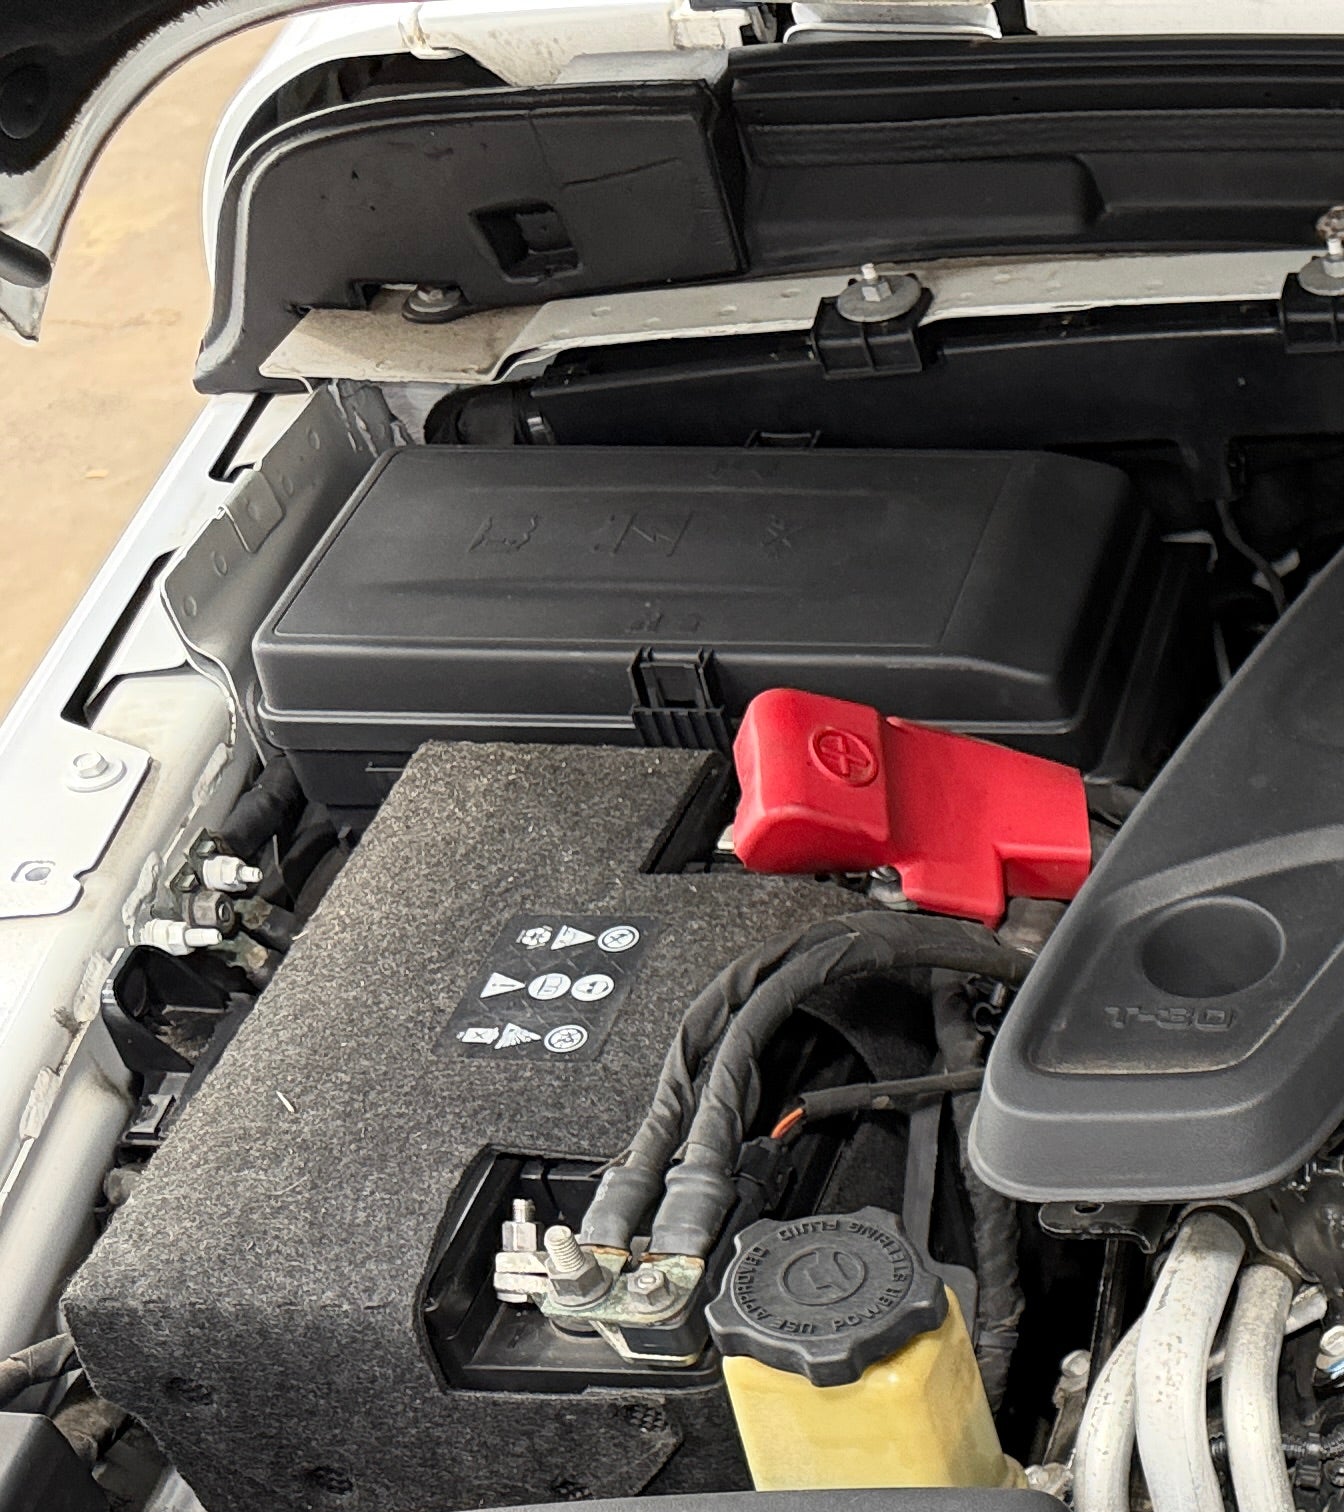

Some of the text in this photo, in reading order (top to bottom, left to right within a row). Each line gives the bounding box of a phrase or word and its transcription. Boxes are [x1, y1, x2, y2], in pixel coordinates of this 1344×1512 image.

[1104, 1006, 1234, 1032] T-30
[735, 1245, 816, 1335] USE APPROVED
[777, 1219, 908, 1334] POWER STEERING FLUID
